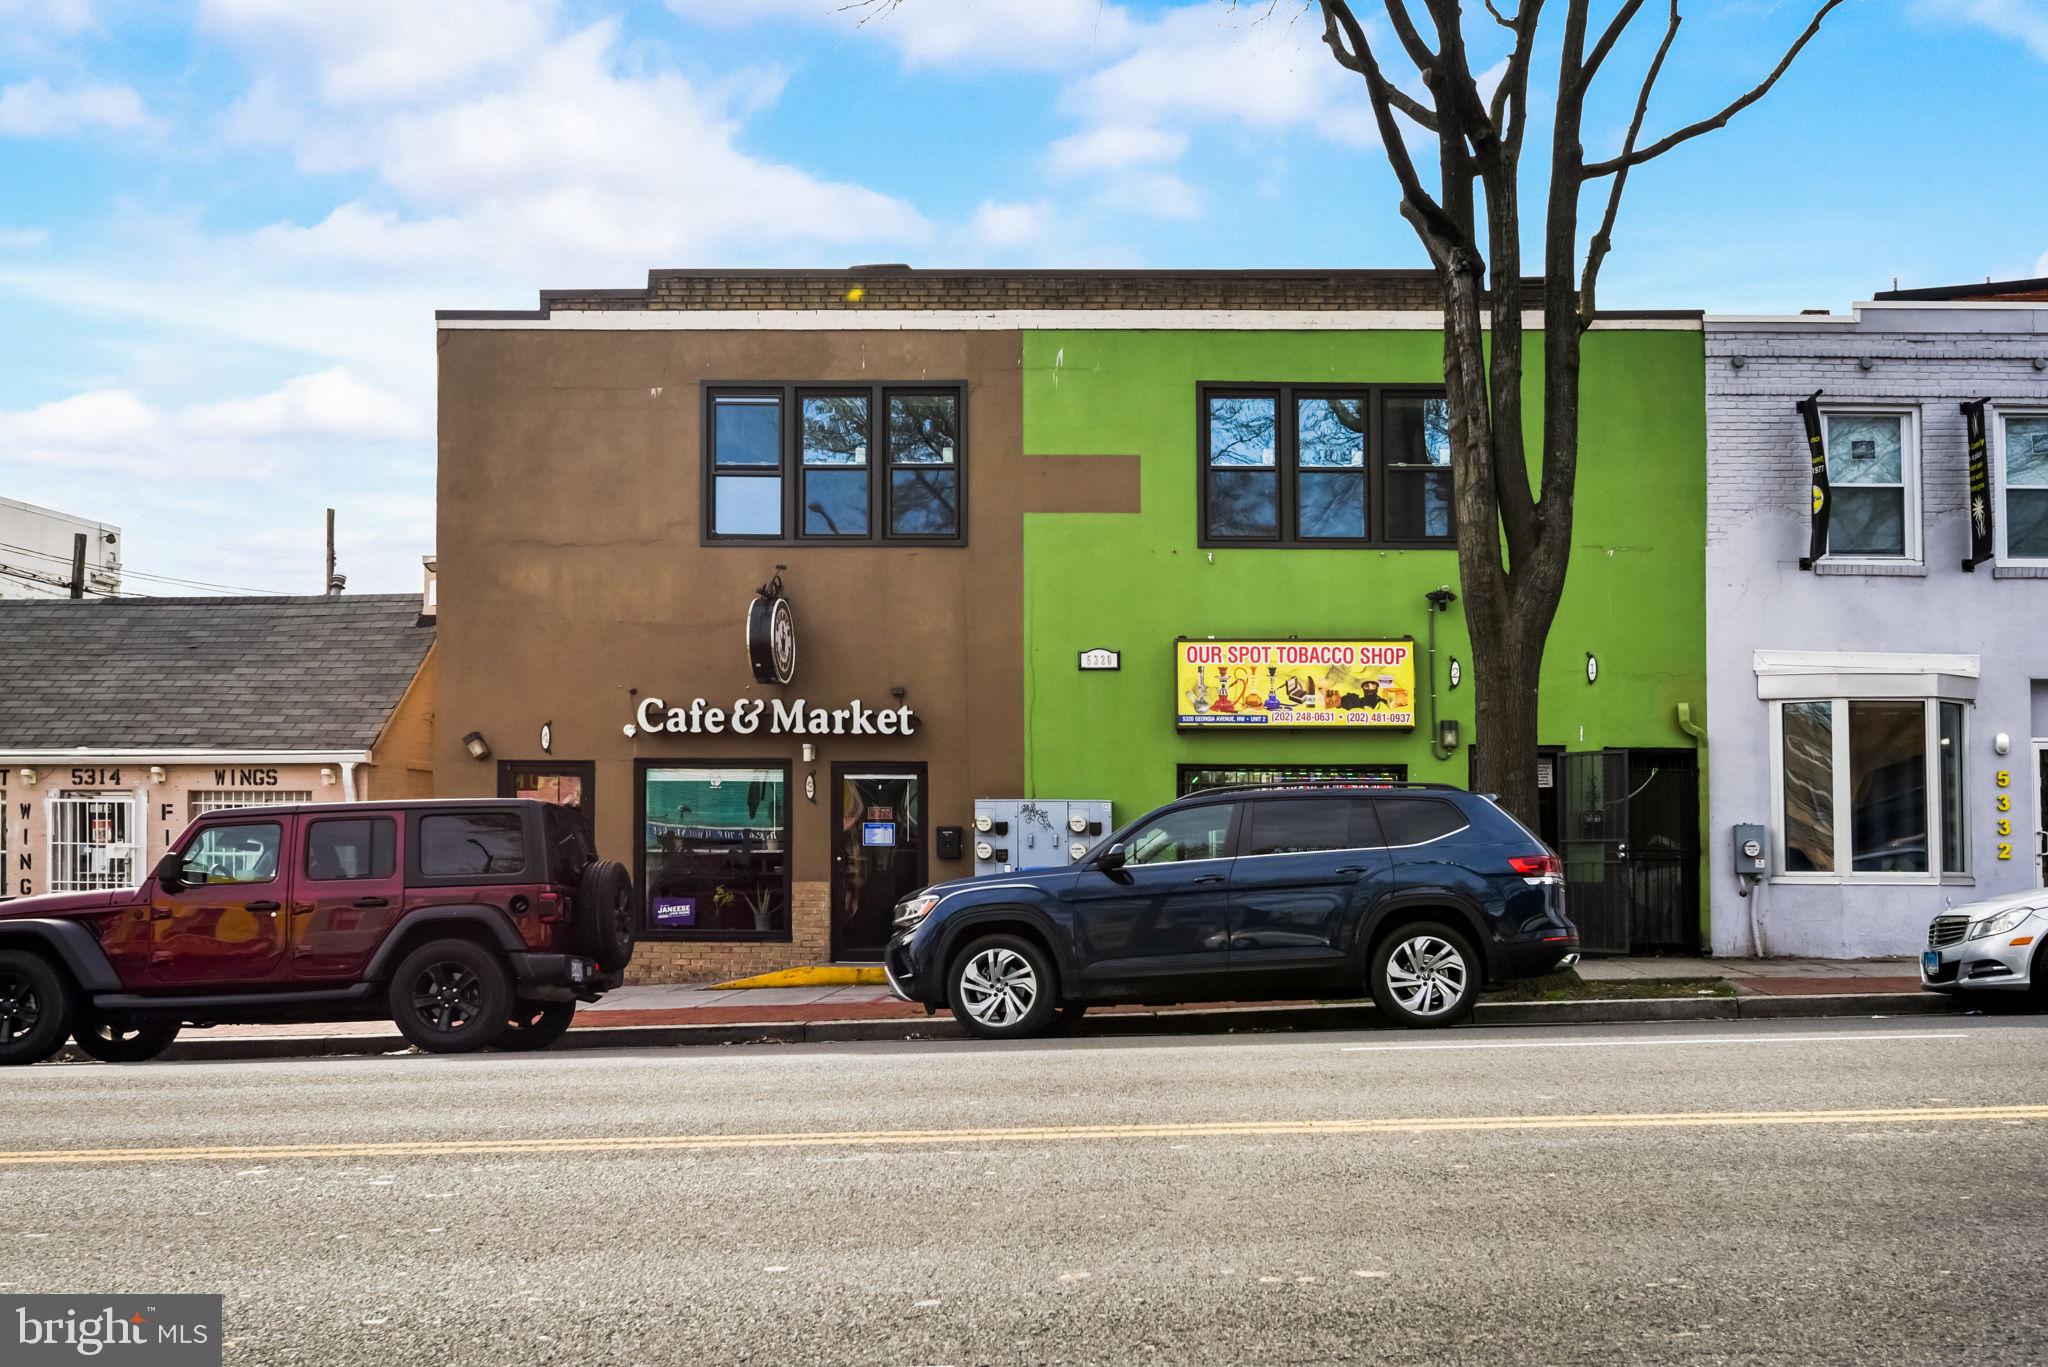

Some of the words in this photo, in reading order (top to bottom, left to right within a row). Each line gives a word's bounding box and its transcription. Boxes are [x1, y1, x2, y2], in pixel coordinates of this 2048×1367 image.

[1086, 654, 1112, 666] 5320
[1186, 646, 1222, 664] OUR
[1228, 646, 1271, 664] SPOT
[1277, 646, 1354, 665] TOBACCO
[1360, 647, 1407, 665] SHOP
[636, 697, 725, 734] Cafe
[731, 698, 765, 735] &
[771, 698, 915, 736] Market
[1271, 713, 1293, 723] (202)
[1296, 712, 1335, 722] 248-0631
[1346, 713, 1369, 723] (202)
[1371, 713, 1411, 724] 481-0937
[71, 768, 121, 786] 5314
[214, 768, 279, 786] WINGS
[1996, 770, 2013, 861] 5332
[658, 904, 691, 913] JANEESE
